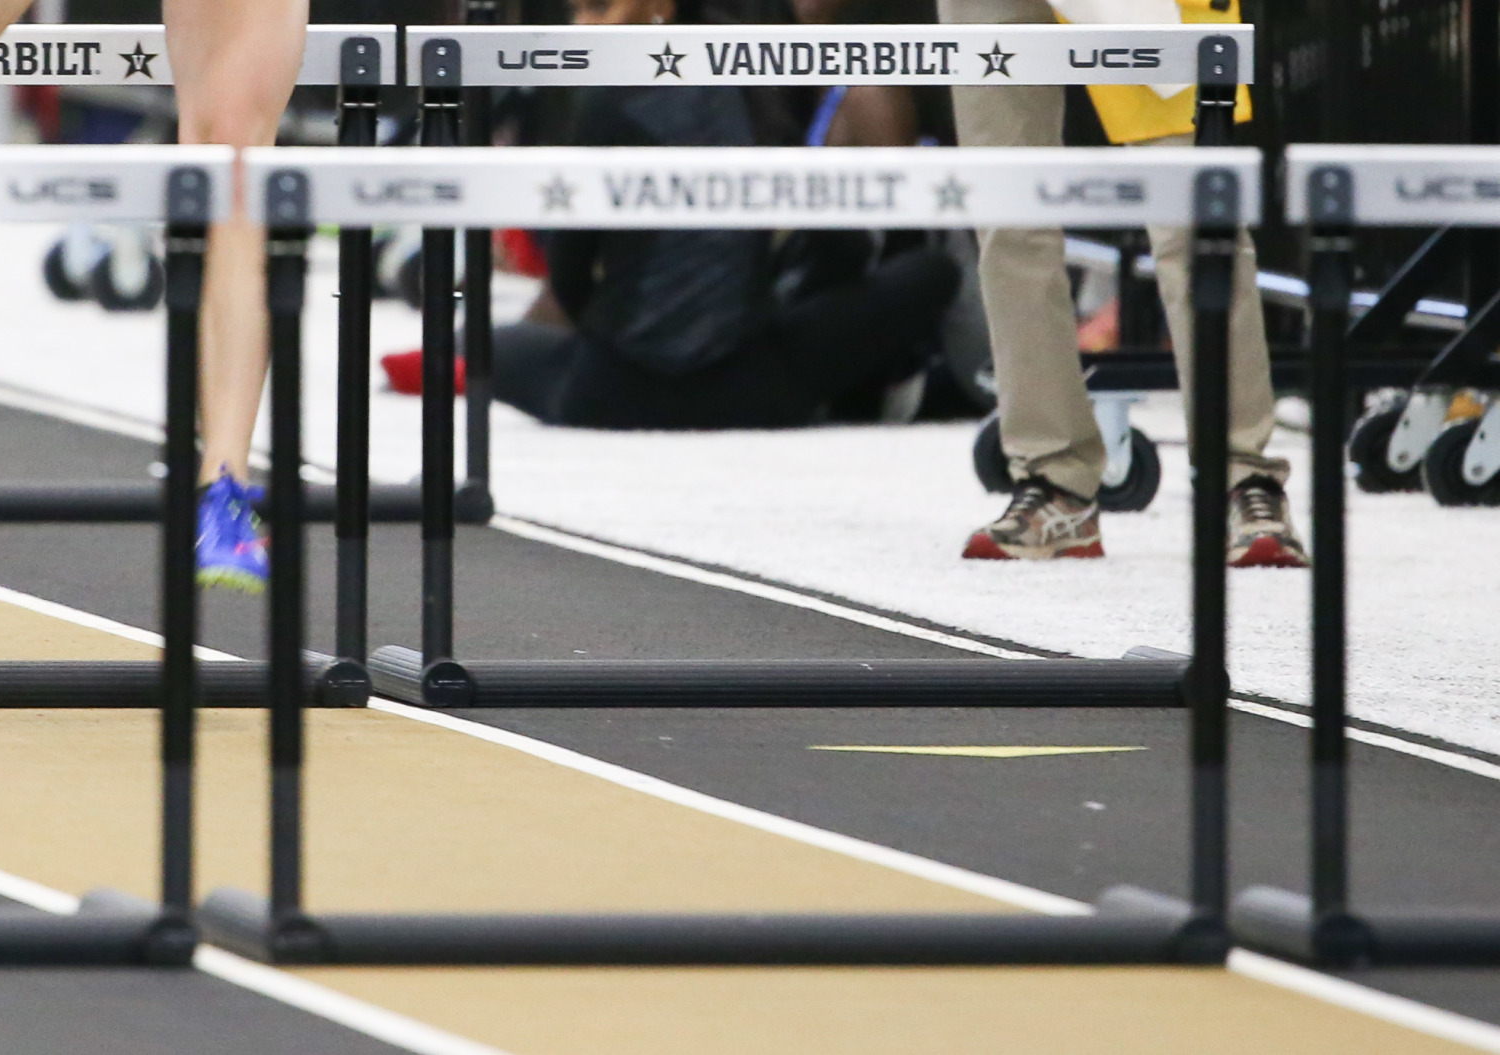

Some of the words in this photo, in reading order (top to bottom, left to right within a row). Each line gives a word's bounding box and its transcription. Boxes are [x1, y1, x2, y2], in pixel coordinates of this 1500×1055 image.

[497, 49, 589, 70] UCS
[705, 41, 958, 76] VANDERBILT
[1069, 48, 1161, 69] UCS
[9, 177, 120, 205] UCS
[353, 178, 463, 206] UCS
[602, 170, 906, 212] VANDERBILT
[1037, 178, 1148, 206] UCS
[1395, 175, 1500, 203] UCS
